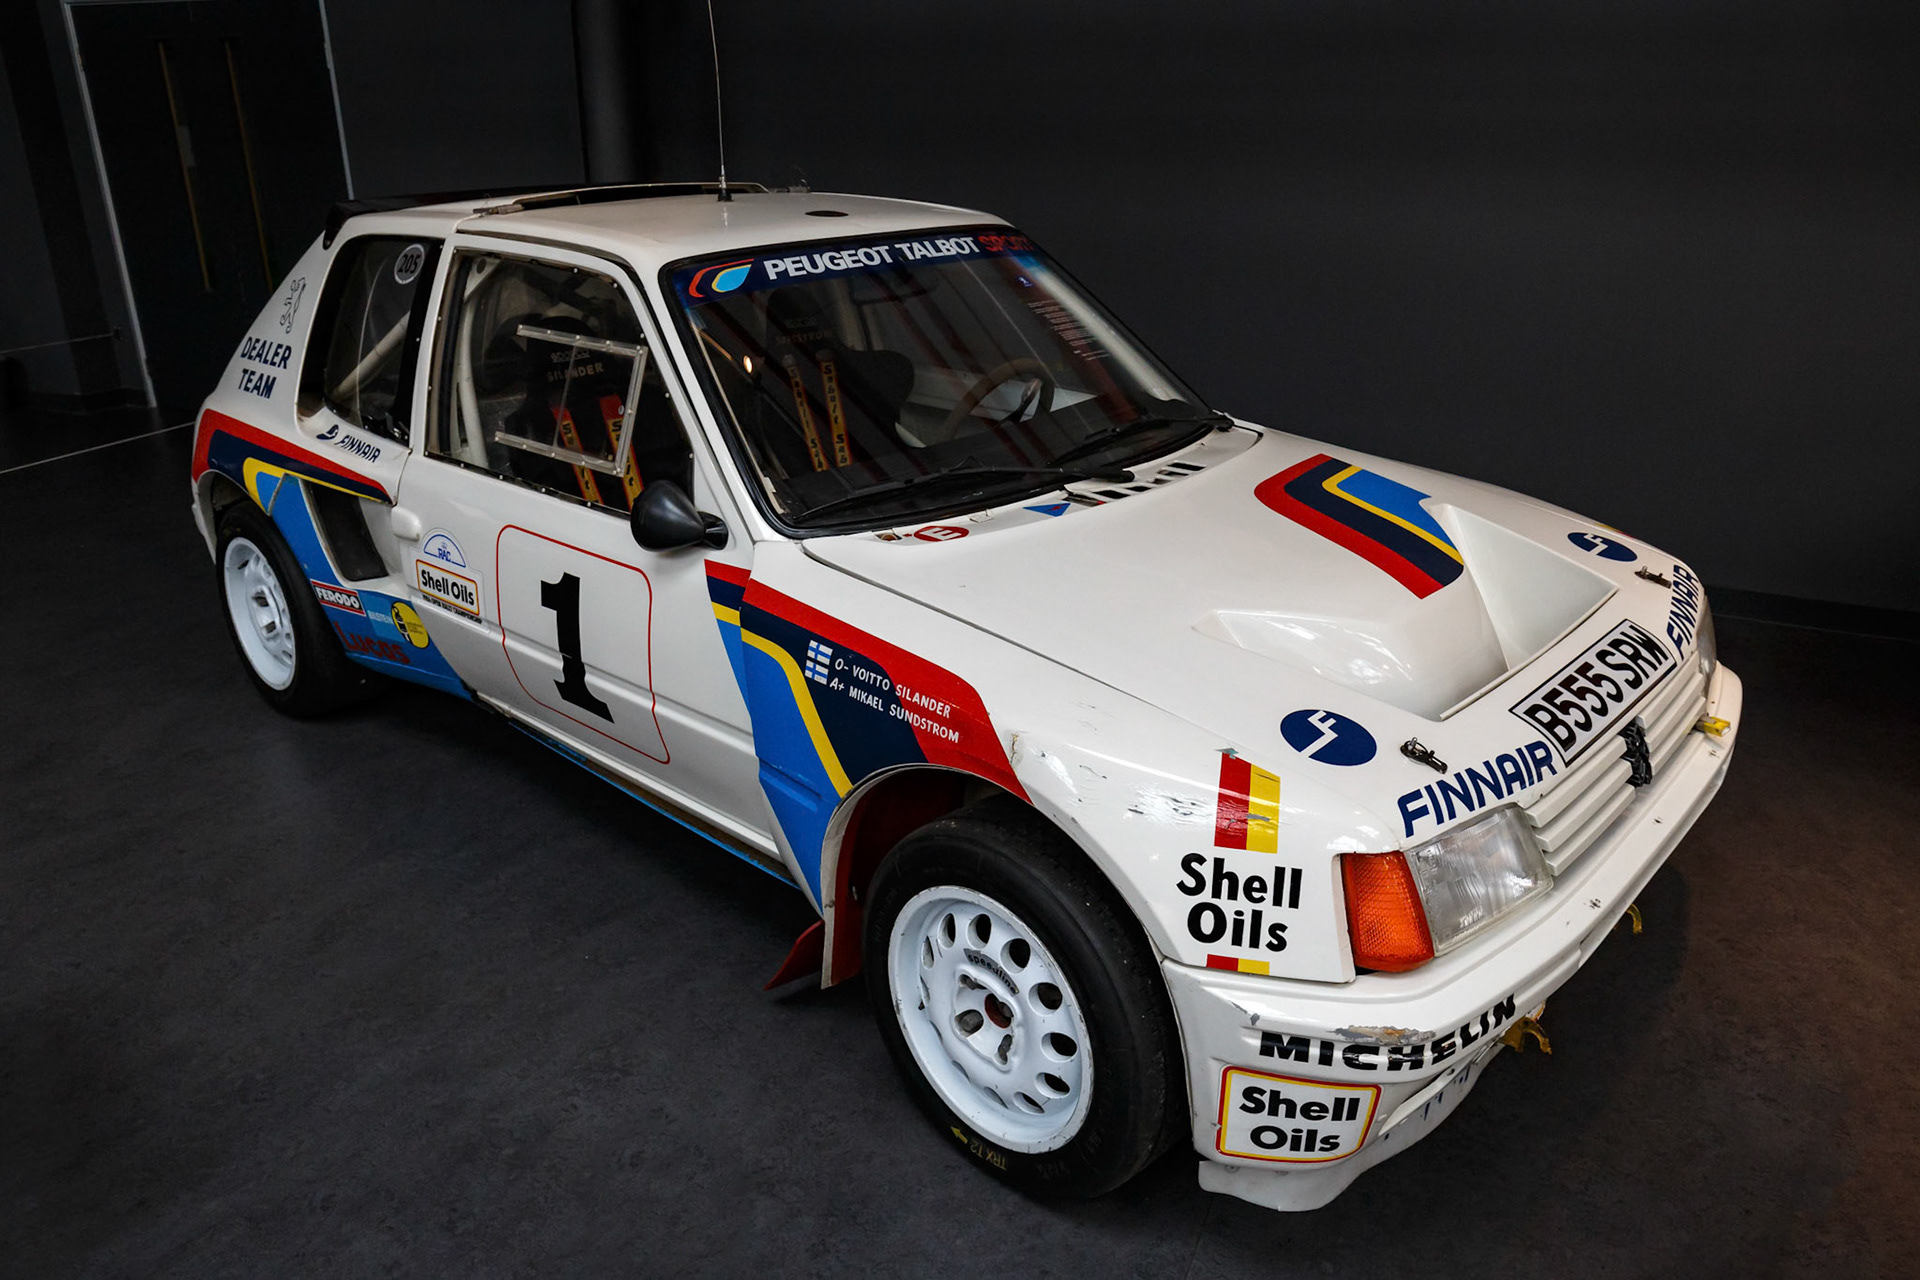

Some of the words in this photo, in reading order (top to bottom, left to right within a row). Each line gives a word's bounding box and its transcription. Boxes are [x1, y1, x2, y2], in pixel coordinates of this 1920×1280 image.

[397, 253, 421, 274] 205
[763, 245, 894, 281] PEUGEOT
[894, 236, 981, 261] TALBOT
[977, 234, 1035, 252] SPORT
[240, 336, 292, 370] DEALER
[238, 368, 277, 399] TEAM
[334, 434, 381, 464] FINNAIR
[437, 547, 452, 562] RAC
[315, 586, 360, 609] FERODO
[421, 569, 449, 596] Shell
[450, 581, 475, 606] Oils
[1666, 564, 1699, 660] FINNAIR
[540, 571, 616, 724] 1
[852, 664, 891, 691] VOITTO
[895, 684, 951, 719] SILANDER
[1523, 661, 1624, 752] B555
[1595, 624, 1669, 690] SRW
[849, 685, 884, 712] MIKAEL
[889, 704, 959, 744] SUNDSTROM
[1397, 739, 1558, 838] FINNAIR
[1176, 852, 1303, 910] Shell
[1187, 901, 1289, 953] Oils
[1259, 992, 1516, 1072] MICHELIN
[1239, 1085, 1360, 1122] Shell
[1250, 1124, 1341, 1153] Oils
[985, 1155, 1007, 1171] TRX
